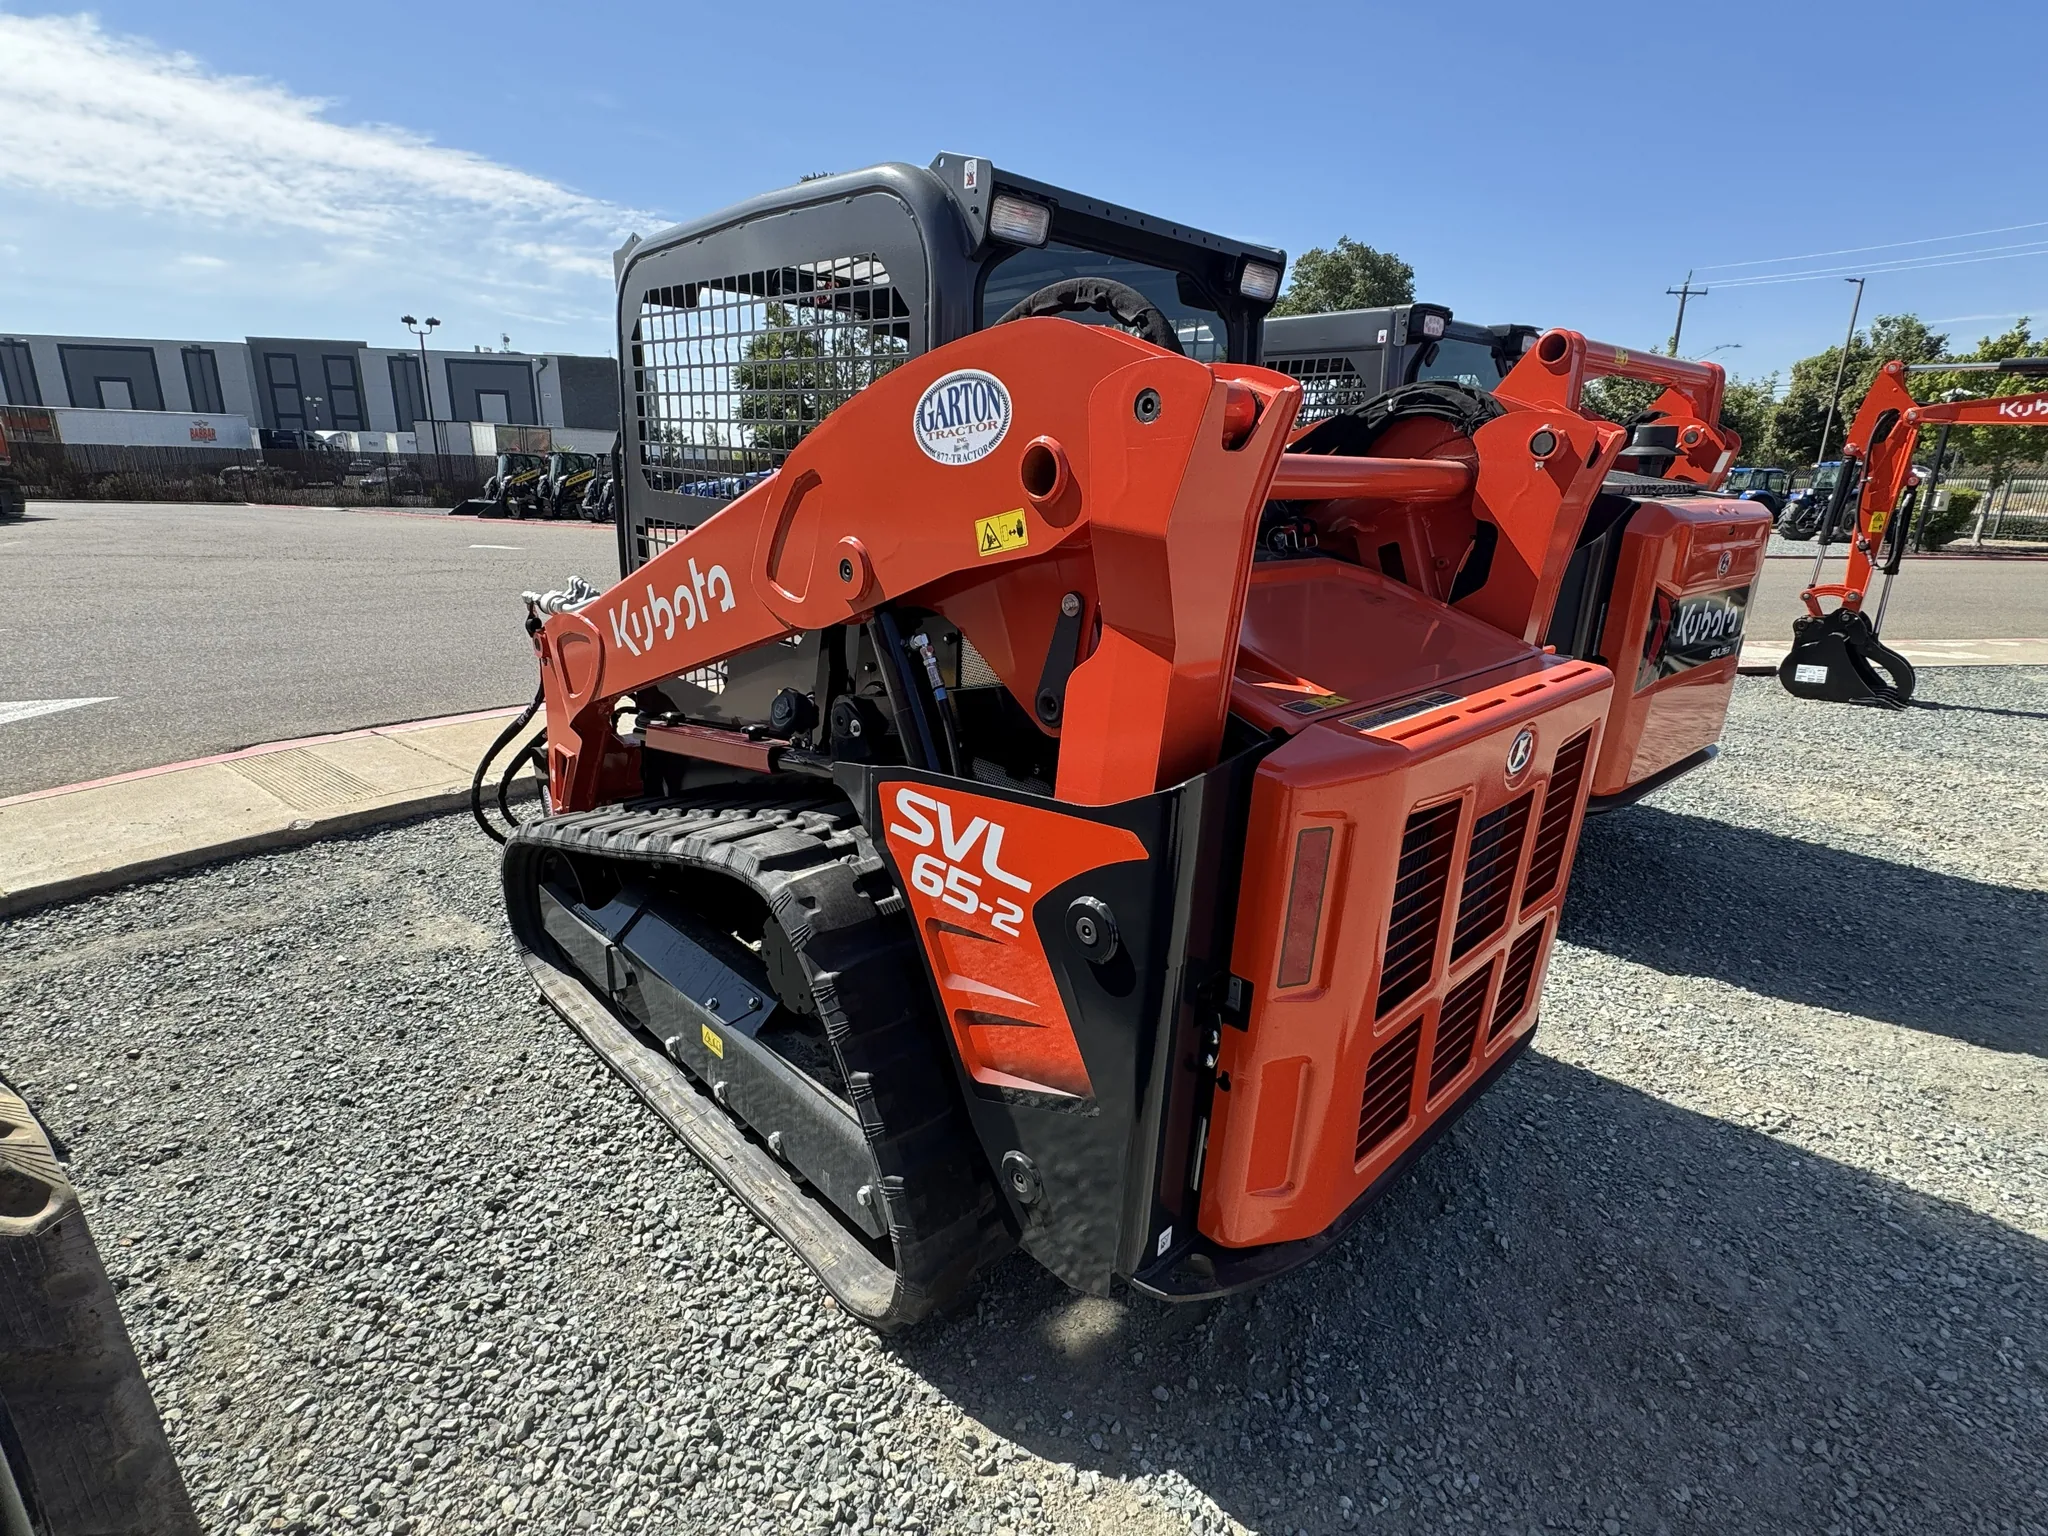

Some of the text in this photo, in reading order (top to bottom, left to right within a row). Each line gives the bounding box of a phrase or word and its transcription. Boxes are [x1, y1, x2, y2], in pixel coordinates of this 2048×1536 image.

[920, 381, 1002, 433] GARTON
[926, 420, 998, 441] TRACTOR
[609, 557, 736, 656] Kubota
[1676, 596, 1738, 646] Kubota
[889, 787, 1033, 894] SVL
[911, 853, 1024, 938] 65-2
